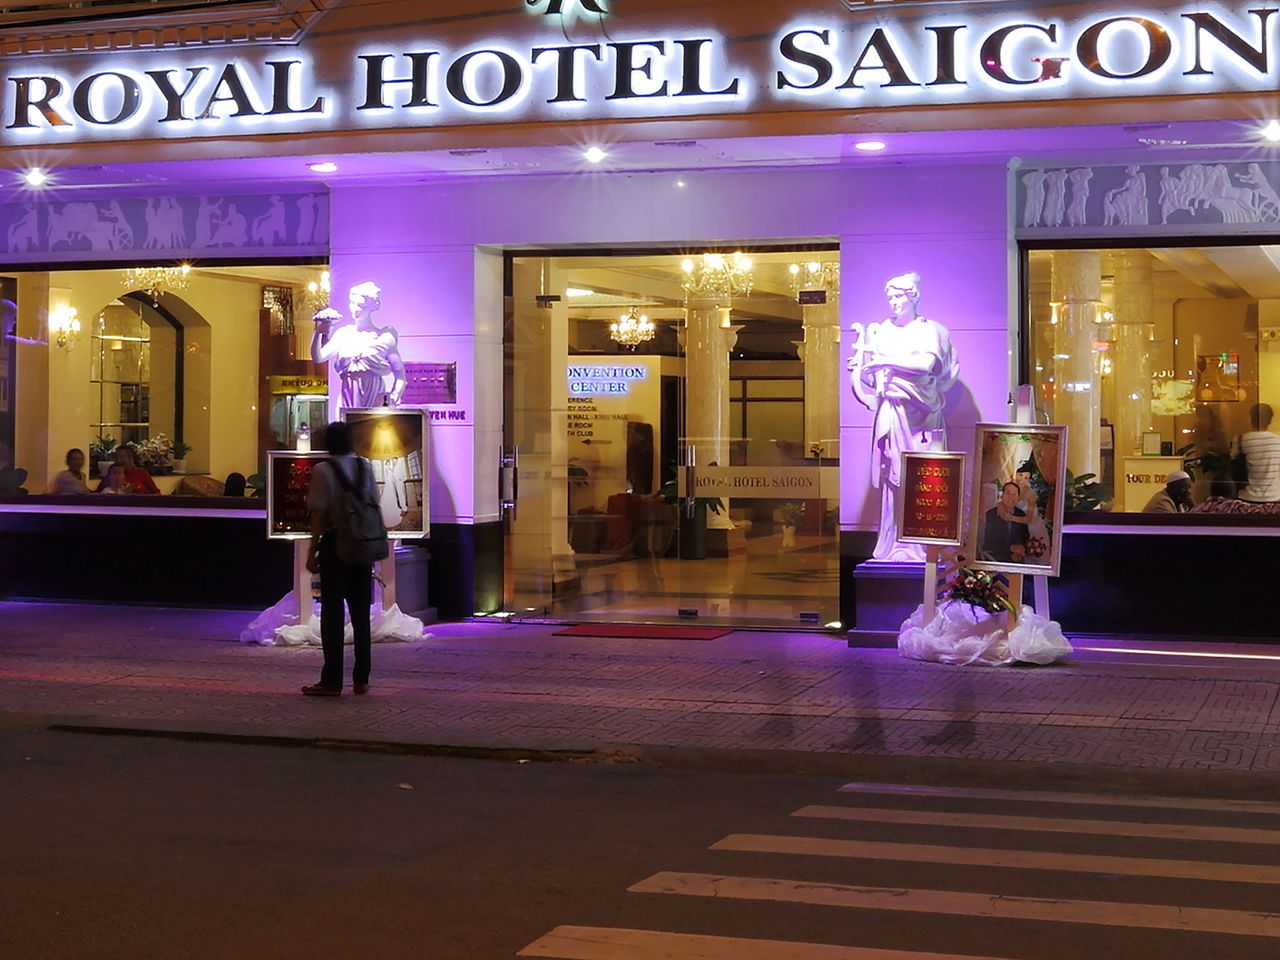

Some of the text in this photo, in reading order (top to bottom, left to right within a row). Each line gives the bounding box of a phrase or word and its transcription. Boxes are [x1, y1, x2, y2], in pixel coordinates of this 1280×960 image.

[6, 7, 1280, 130] ROYAL HOTEL SAIGON
[570, 381, 628, 393] CENTER
[734, 475, 770, 487] HOTEL
[772, 475, 813, 488] SAIGON
